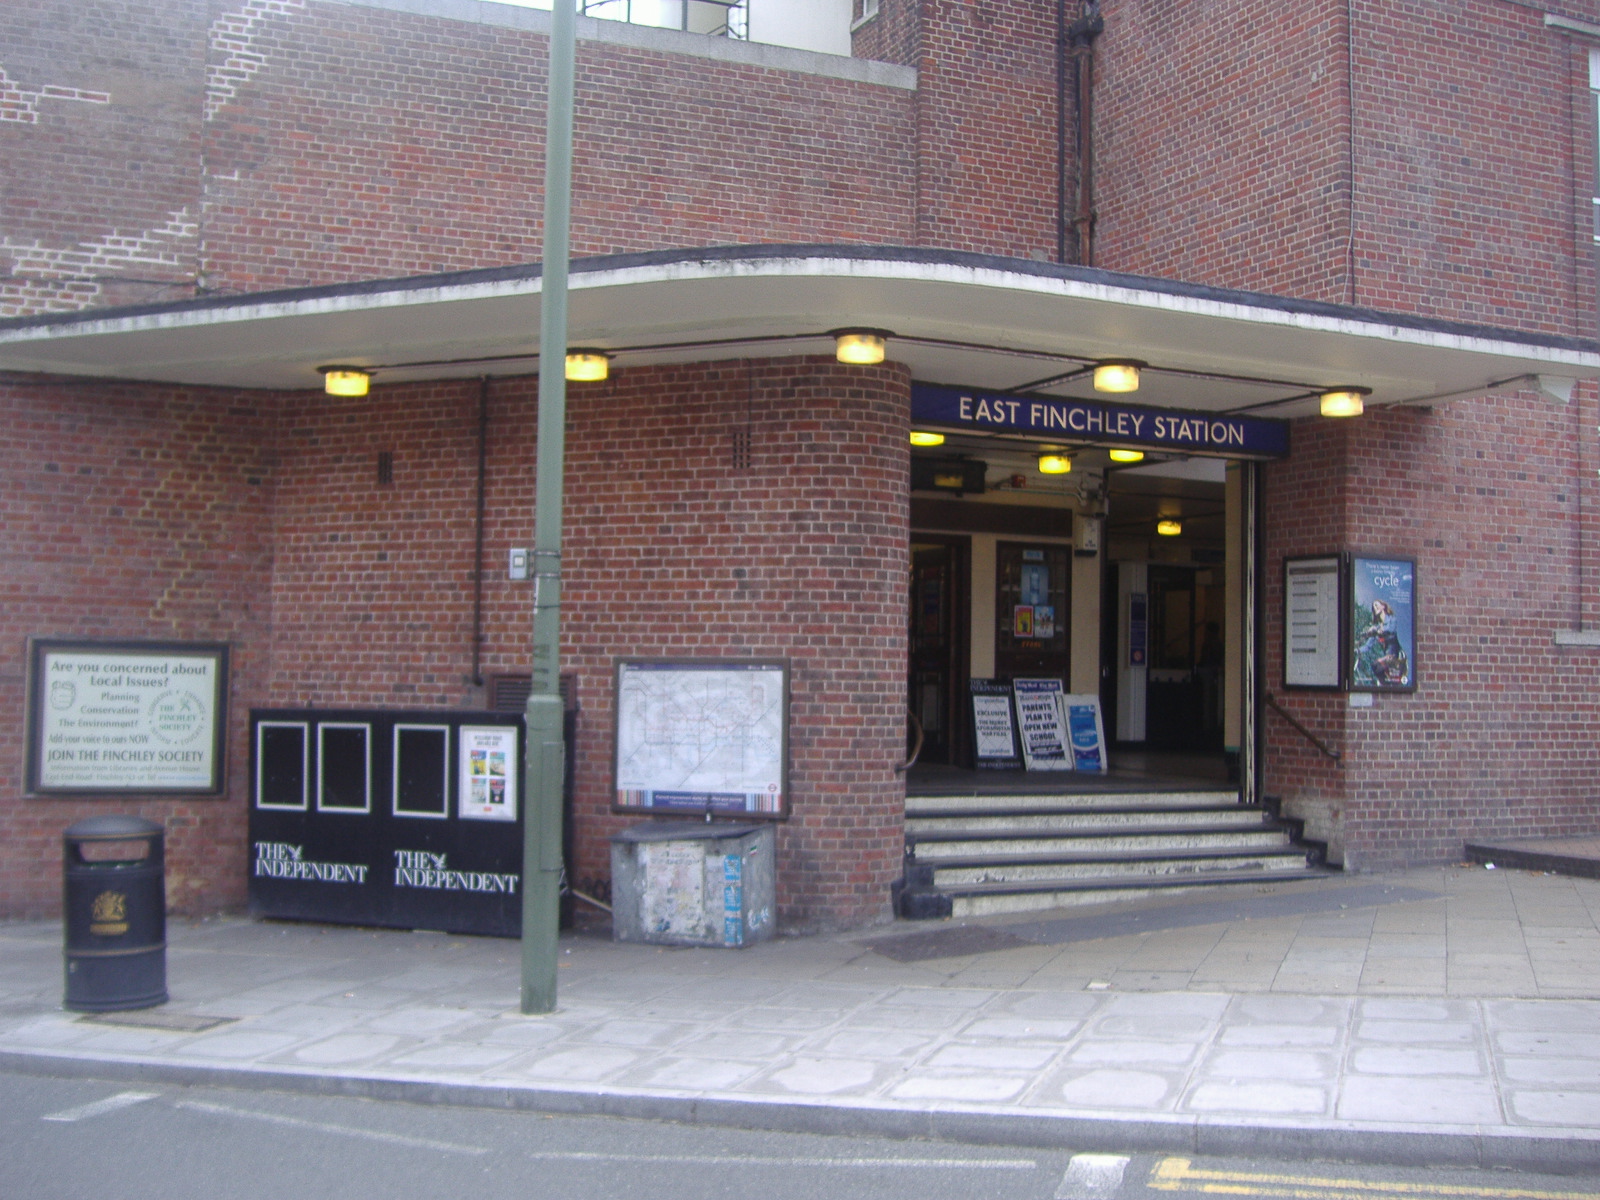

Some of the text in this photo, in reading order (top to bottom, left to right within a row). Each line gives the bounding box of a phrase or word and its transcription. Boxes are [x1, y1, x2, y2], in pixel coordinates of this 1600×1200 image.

[959, 396, 1245, 445] EAST FINCHLEY STATION
[1374, 574, 1399, 589] cycle
[51, 660, 207, 675] Are you concerned about
[90, 675, 169, 688] Local Issues?
[101, 692, 140, 704] Planning
[80, 705, 139, 714] Conservation
[976, 709, 1008, 717] EXCLUSIVE
[1022, 703, 1052, 712] PARENTS
[58, 718, 75, 727] The
[159, 714, 197, 722] FINCHLEY
[1025, 712, 1053, 721] PLAN TO
[160, 723, 191, 731] SOCIETY
[1024, 722, 1057, 731] OPEN NEW
[48, 733, 63, 744] Add
[82, 734, 101, 744] voice
[102, 734, 111, 744] to
[128, 734, 149, 745] NOW
[1029, 732, 1056, 740] SCHOOL
[46, 749, 204, 762] JOIN THE FINCHLEY SOCIETY
[255, 842, 288, 860] THE
[394, 850, 431, 869] THE
[255, 859, 369, 884] INDEPENDENT
[394, 867, 519, 894] INDEPENDENT
